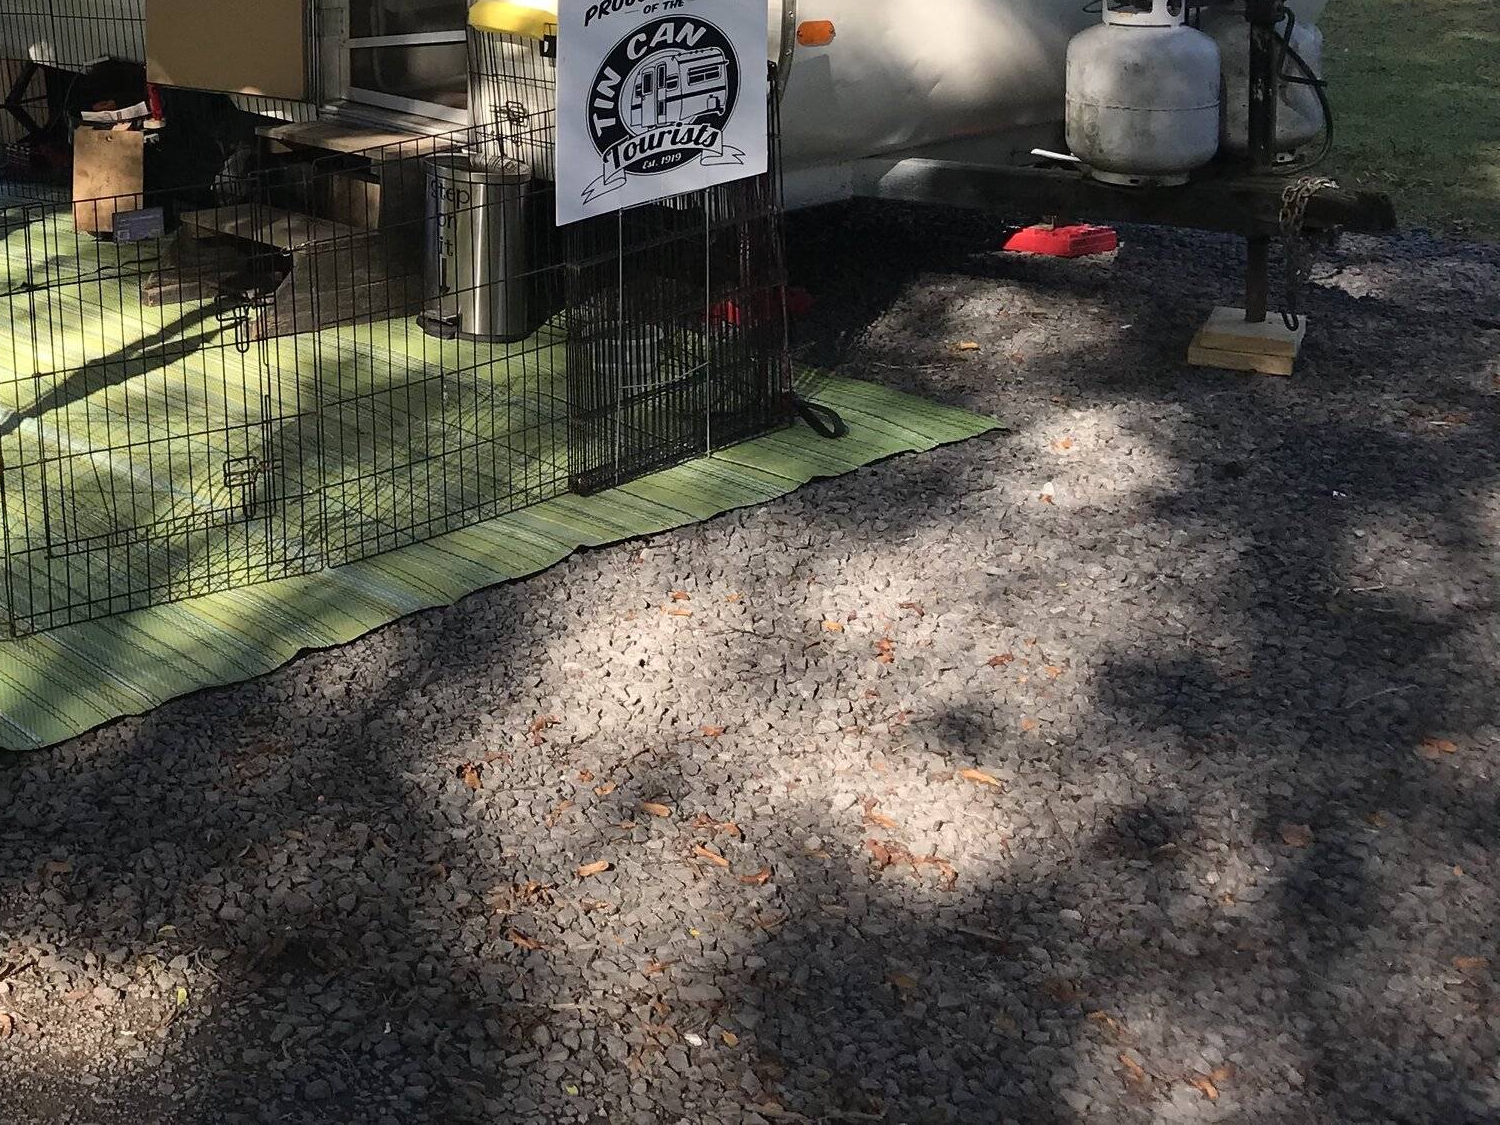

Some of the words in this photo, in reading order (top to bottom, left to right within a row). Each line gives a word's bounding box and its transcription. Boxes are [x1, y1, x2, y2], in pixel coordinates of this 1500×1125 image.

[643, 3, 659, 16] OF
[592, 65, 623, 139] TIN
[626, 21, 707, 61] CAN
[602, 121, 720, 171] Tourists
[660, 151, 683, 166] 1919
[430, 178, 470, 209] Step
